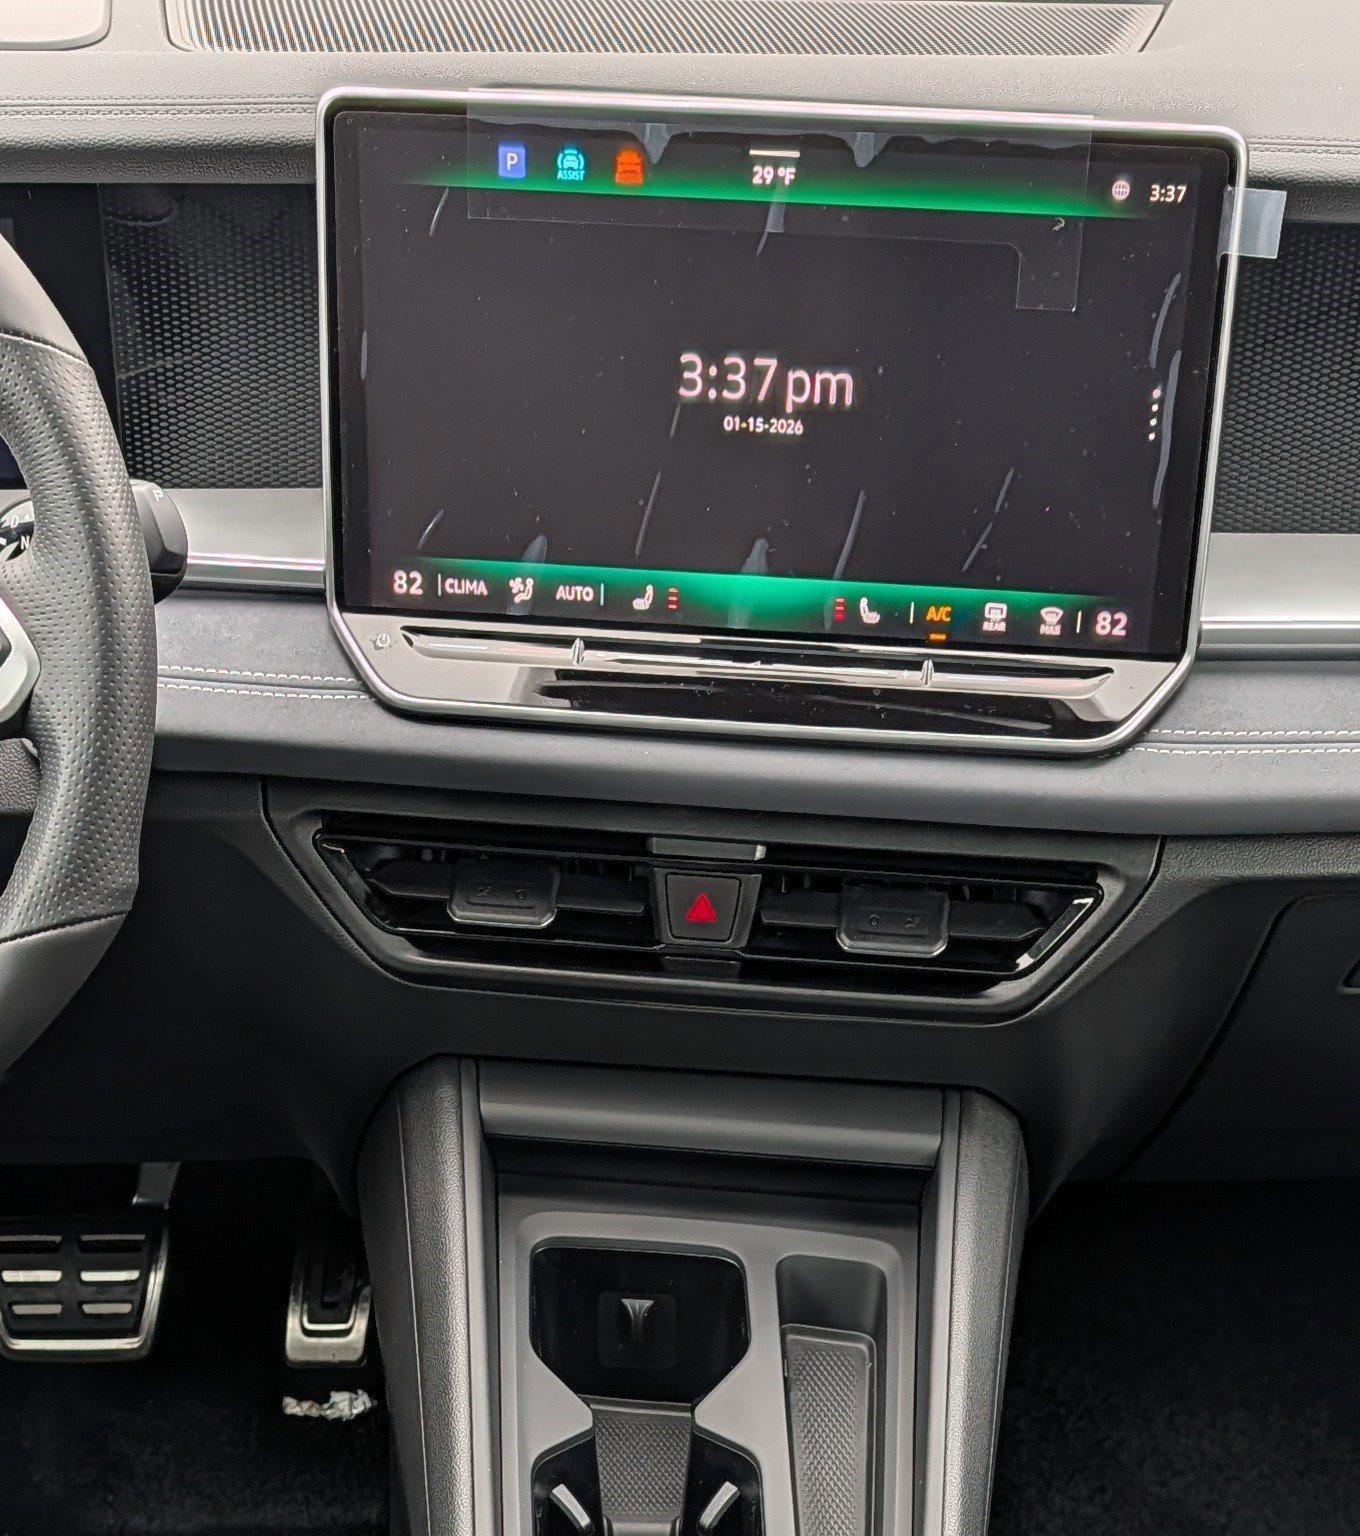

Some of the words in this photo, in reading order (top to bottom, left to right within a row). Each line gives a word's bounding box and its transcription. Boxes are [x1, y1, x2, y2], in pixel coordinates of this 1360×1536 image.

[507, 153, 518, 170] P
[556, 169, 586, 181] ASSIST
[752, 165, 774, 184] 29
[777, 166, 796, 184] °F
[1149, 185, 1187, 203] 3:37
[678, 353, 778, 402] 3:37
[785, 369, 854, 413] pm
[723, 415, 804, 435] 01-15-2026
[20, 534, 31, 551] N
[393, 571, 424, 595] 82
[444, 578, 488, 596] CLIMA
[555, 585, 595, 602] AUTO
[926, 606, 952, 622] A/C
[1095, 611, 1128, 637] 82
